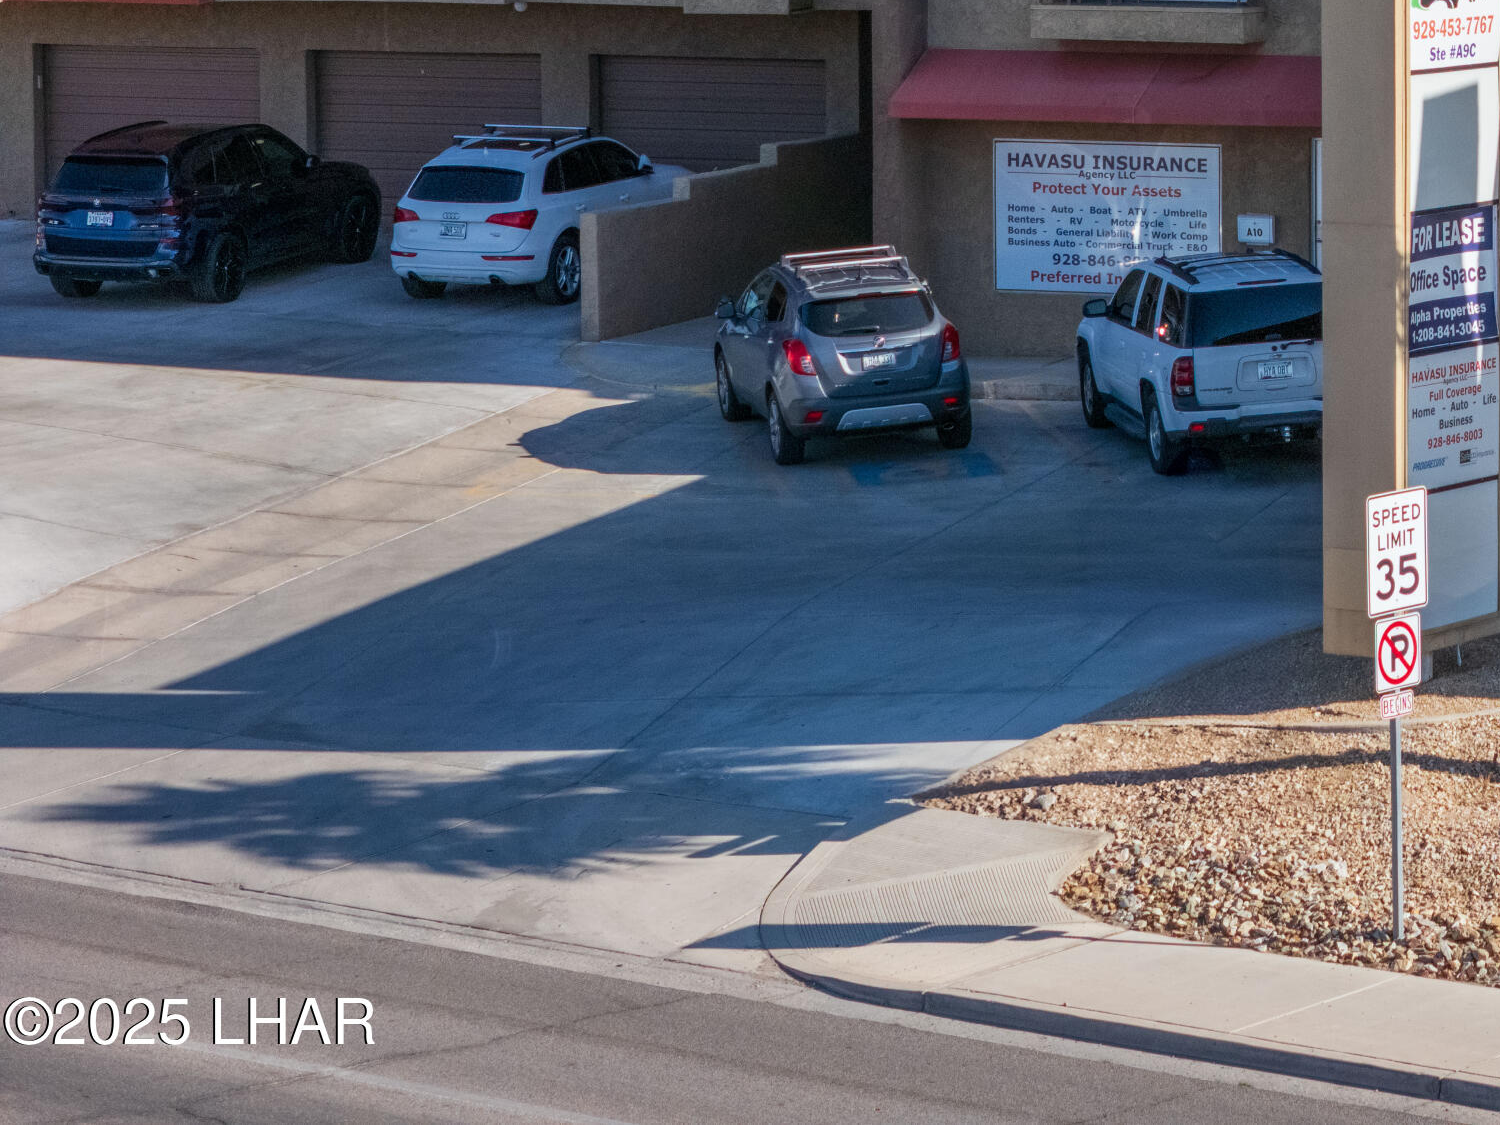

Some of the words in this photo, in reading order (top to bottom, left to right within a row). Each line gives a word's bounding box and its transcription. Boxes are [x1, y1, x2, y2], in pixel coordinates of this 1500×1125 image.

[1413, 15, 1494, 40] 928-453-7767
[1430, 46, 1446, 61] Ste
[1450, 42, 1476, 59] #A9C
[1007, 152, 1085, 169] HAVASU
[1093, 155, 1208, 173] INSURANCE
[1078, 170, 1115, 181] Agency
[1118, 171, 1136, 180] LLC
[1032, 181, 1087, 195] Protect
[1092, 183, 1127, 196] Your
[1131, 184, 1182, 198] Assets
[1007, 203, 1035, 213] Home
[1051, 205, 1074, 214] Auto
[1089, 206, 1112, 215] Boat
[1127, 207, 1147, 216] ATV
[1163, 208, 1208, 218] Umbrella
[1007, 215, 1046, 224] Renters
[1070, 217, 1083, 225] RV
[1111, 218, 1164, 229] Motocycle
[1189, 221, 1207, 229] Life
[1247, 227, 1263, 237] A10
[1007, 226, 1037, 235] Bonds
[1056, 228, 1093, 236] General
[1151, 231, 1177, 240] Work
[1180, 232, 1208, 242] Comp
[1411, 225, 1433, 254] FOR
[1435, 216, 1486, 249] LEASE
[1007, 237, 1050, 247] Business
[1053, 239, 1076, 248] Auto
[1085, 240, 1143, 250] Commercial
[1146, 242, 1174, 251] Truck
[1186, 243, 1208, 252] E&O
[1030, 270, 1102, 285] Preferred
[1410, 269, 1439, 293] Office
[1442, 264, 1487, 290] Space
[1410, 309, 1431, 326] Alpha
[1433, 301, 1487, 321] Properties
[1412, 319, 1486, 344] 1-208-841-3045
[1411, 367, 1447, 384] HAVASU
[1449, 357, 1497, 377] INSURANCE
[1429, 388, 1444, 402] Full
[1446, 383, 1482, 398] Coverage
[1411, 406, 1436, 419] Home
[1450, 400, 1468, 412] Auto
[1482, 393, 1497, 405] Life
[1439, 415, 1473, 430] Business
[1427, 428, 1483, 449] 928-846-8003
[1372, 503, 1421, 528] SPEED
[1377, 528, 1415, 552] LIMIT
[1376, 552, 1420, 601] 35
[1383, 695, 1413, 715] BEGINS
